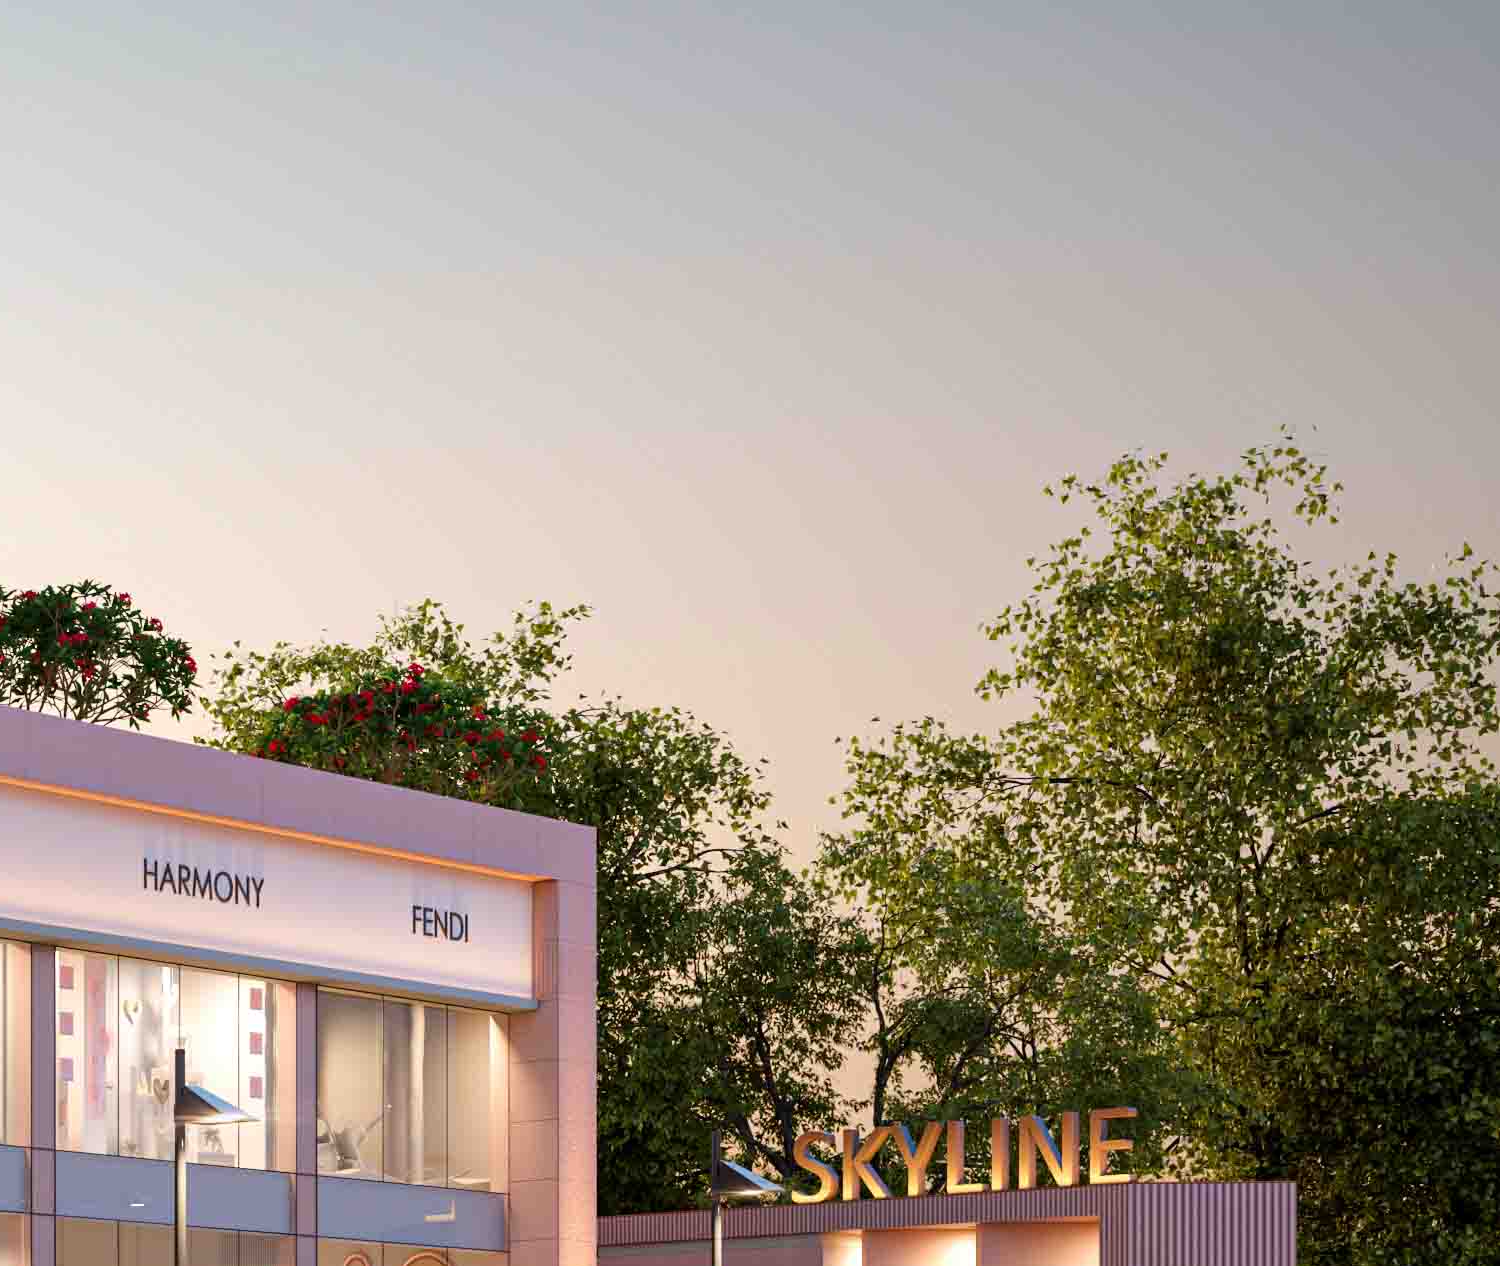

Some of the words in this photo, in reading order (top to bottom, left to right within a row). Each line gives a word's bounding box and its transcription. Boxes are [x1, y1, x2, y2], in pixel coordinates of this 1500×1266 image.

[143, 857, 265, 909] HARMONY
[412, 904, 469, 944] FENDI
[791, 1106, 1138, 1204] SKYLINE
